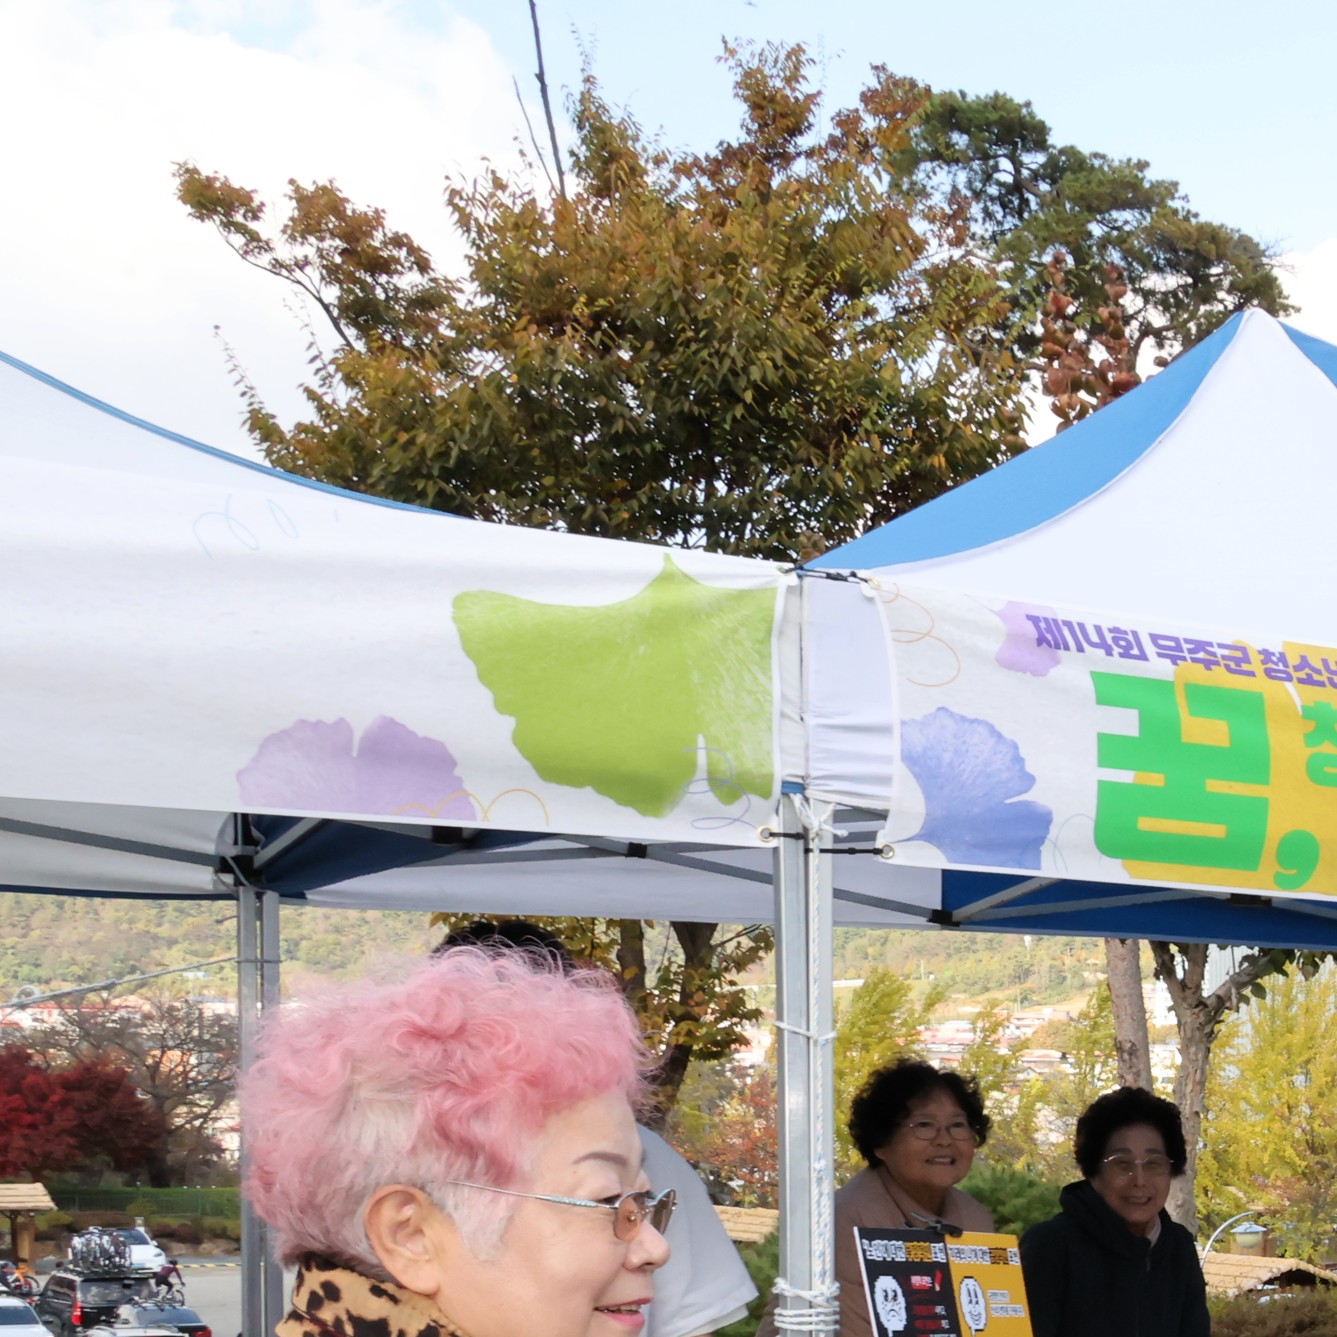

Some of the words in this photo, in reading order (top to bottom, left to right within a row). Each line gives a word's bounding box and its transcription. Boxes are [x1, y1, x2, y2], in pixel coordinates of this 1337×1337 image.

[1025, 614, 1149, 662] 제14회
[1148, 632, 1257, 678] 무주군
[1089, 669, 1320, 891] 꿈,
